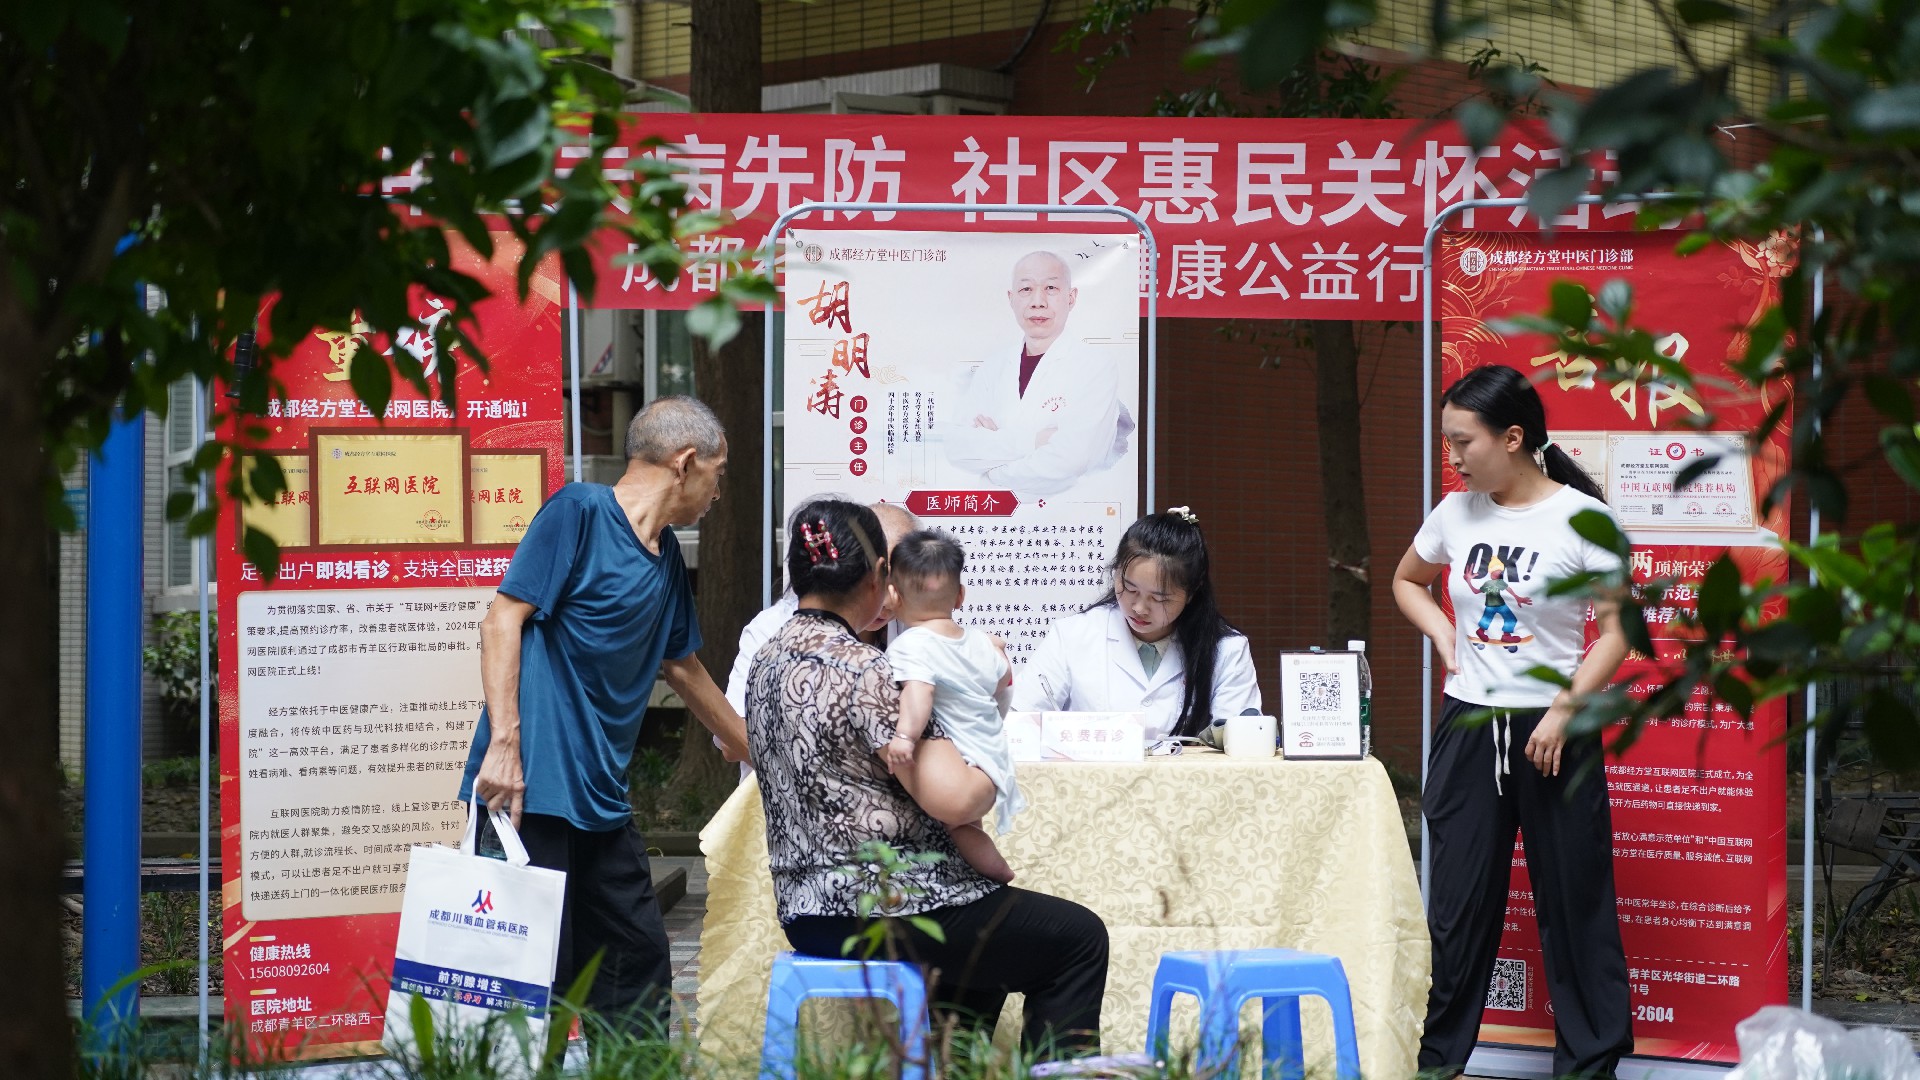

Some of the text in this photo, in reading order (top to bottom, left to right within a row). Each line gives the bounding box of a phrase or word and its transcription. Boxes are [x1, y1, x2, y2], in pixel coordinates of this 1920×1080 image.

[829, 247, 948, 263] 成都经方堂中医门诊部
[1490, 248, 1634, 264] 成都经方堂中医门诊部
[851, 397, 866, 474] 门诊主任
[344, 475, 441, 495] 互联网医院
[926, 493, 1000, 513] 医师简介
[240, 560, 391, 581] 足出户即刻看诊
[1464, 542, 1540, 582] OK!
[429, 909, 529, 937] 成都川蜀血管病医院
[249, 943, 312, 962] 健康热线
[249, 962, 331, 979] 15608092604
[437, 970, 502, 994] 前列腺增生
[250, 996, 313, 1016] 医院地址
